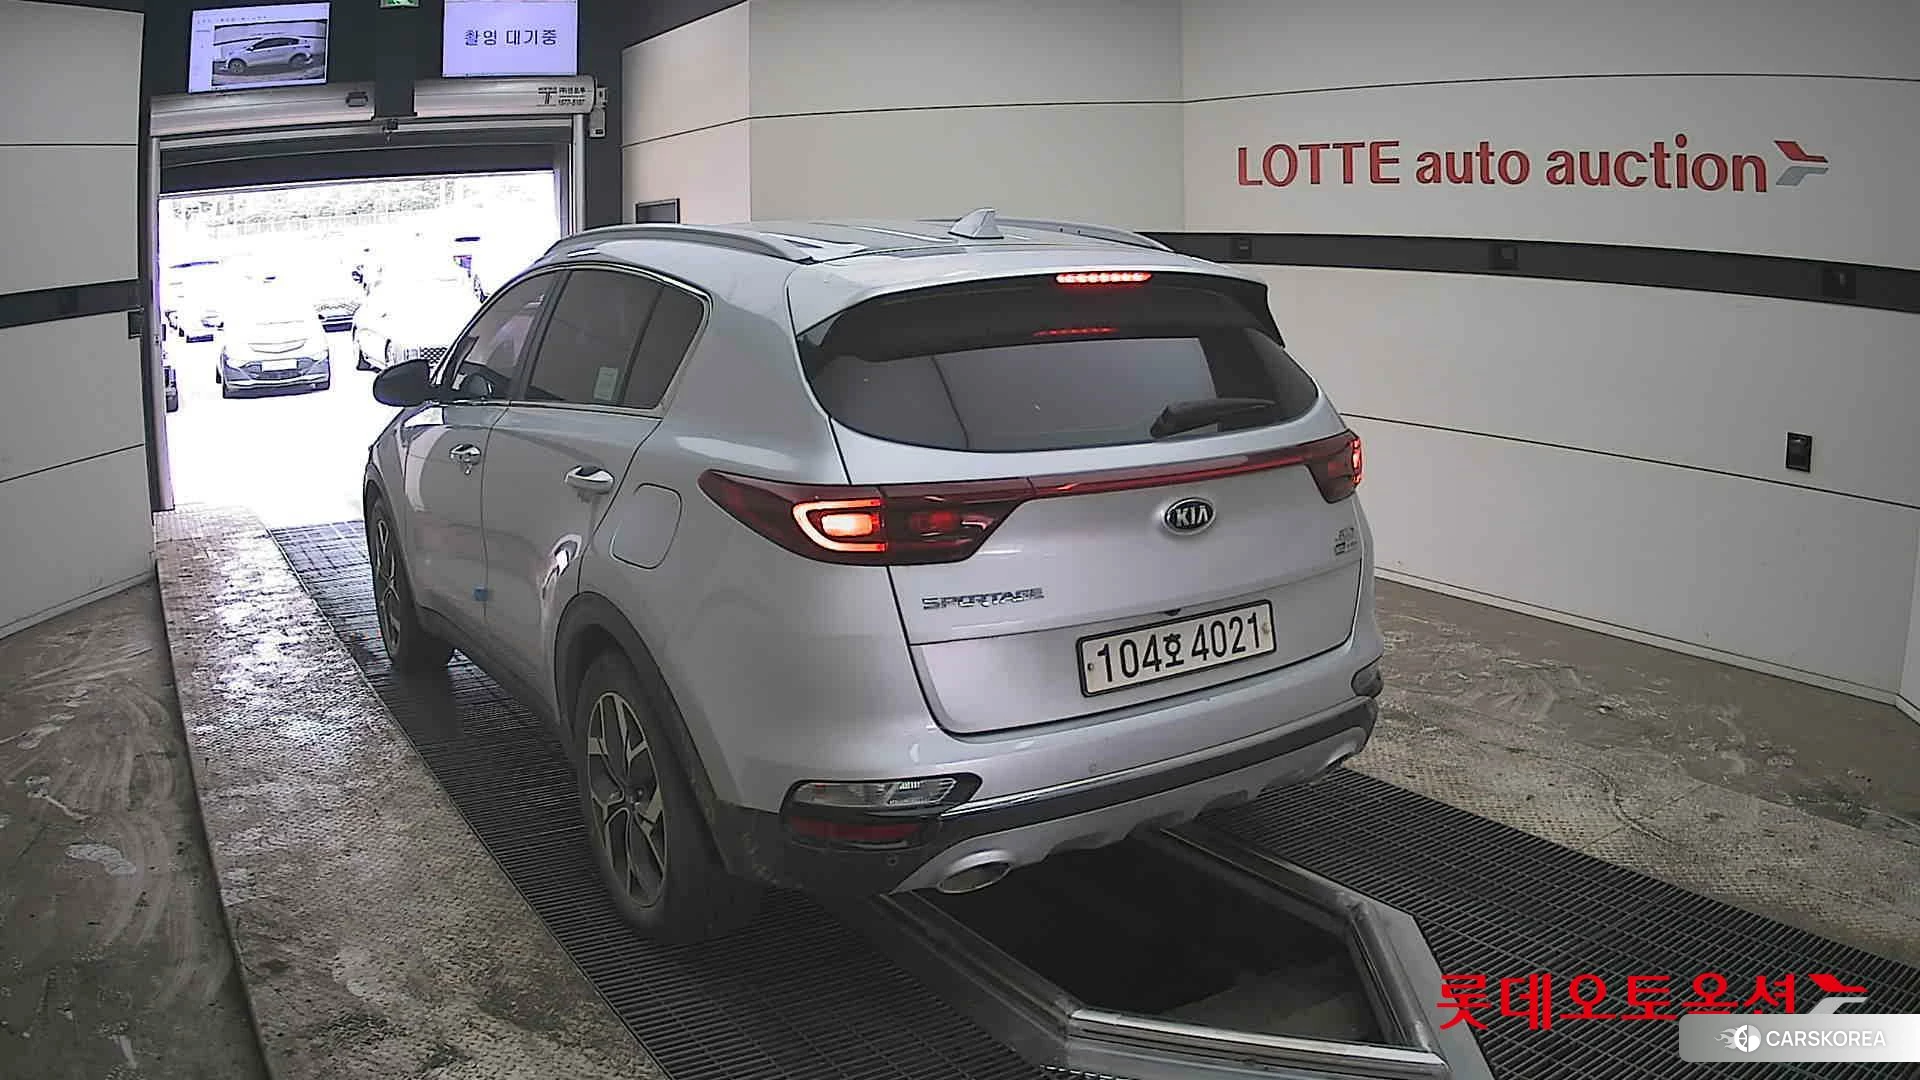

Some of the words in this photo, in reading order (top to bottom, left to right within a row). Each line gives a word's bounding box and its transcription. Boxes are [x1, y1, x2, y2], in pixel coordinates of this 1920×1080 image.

[464, 29, 497, 46] 촬영
[505, 29, 557, 46] 대기중
[1237, 140, 1399, 187] LOTTE
[1415, 141, 1530, 185] auto
[1546, 134, 1767, 193] auction
[1175, 505, 1208, 527] KIA
[921, 587, 1045, 610] SPORTAGE
[1191, 612, 1260, 661] 4021
